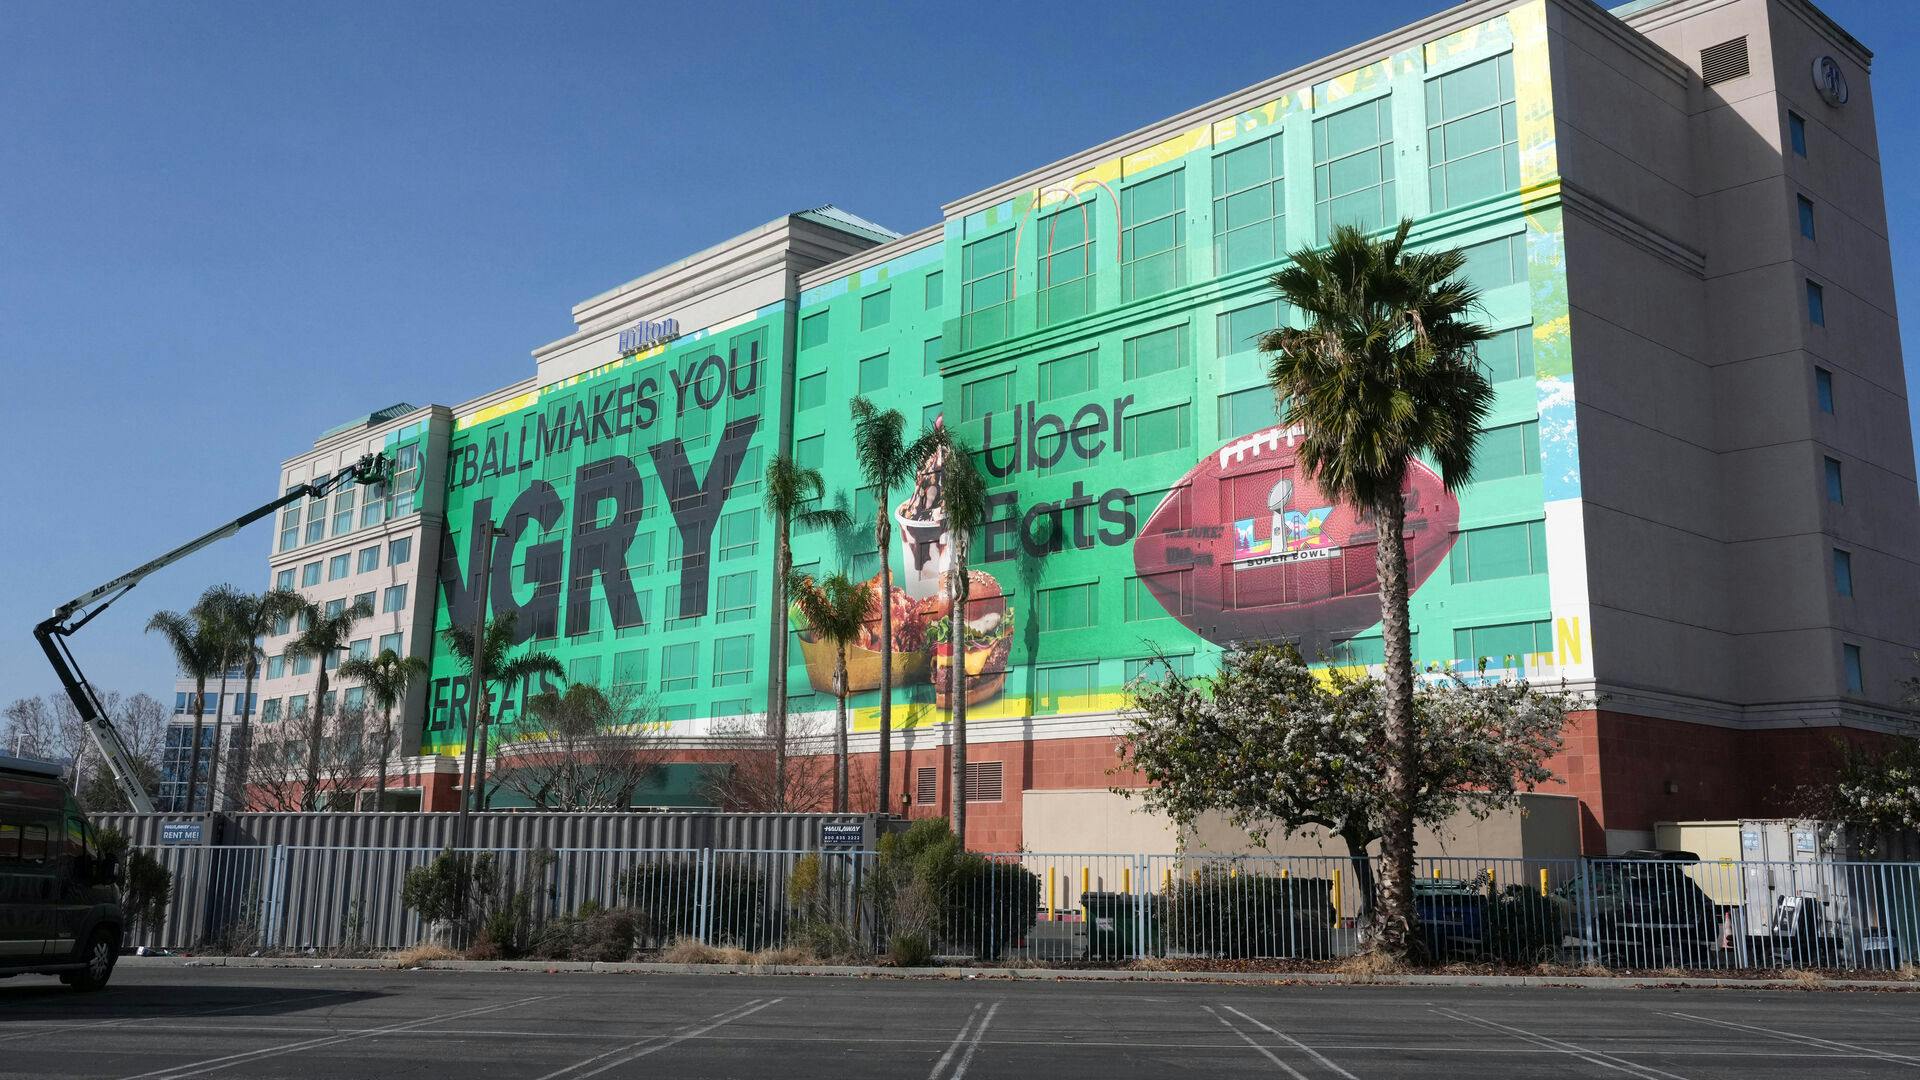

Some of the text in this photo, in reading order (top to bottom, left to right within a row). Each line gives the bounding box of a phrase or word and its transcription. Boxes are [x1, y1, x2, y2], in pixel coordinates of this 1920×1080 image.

[618, 318, 675, 354] Hilton
[535, 377, 658, 461] MAKES
[668, 340, 757, 418] YOU
[983, 394, 1135, 478] Uber
[438, 415, 760, 646] NGRY
[984, 481, 1137, 563] Eats
[1247, 550, 1327, 567] SUPER BOWL
[163, 831, 200, 839] RENT ME!
